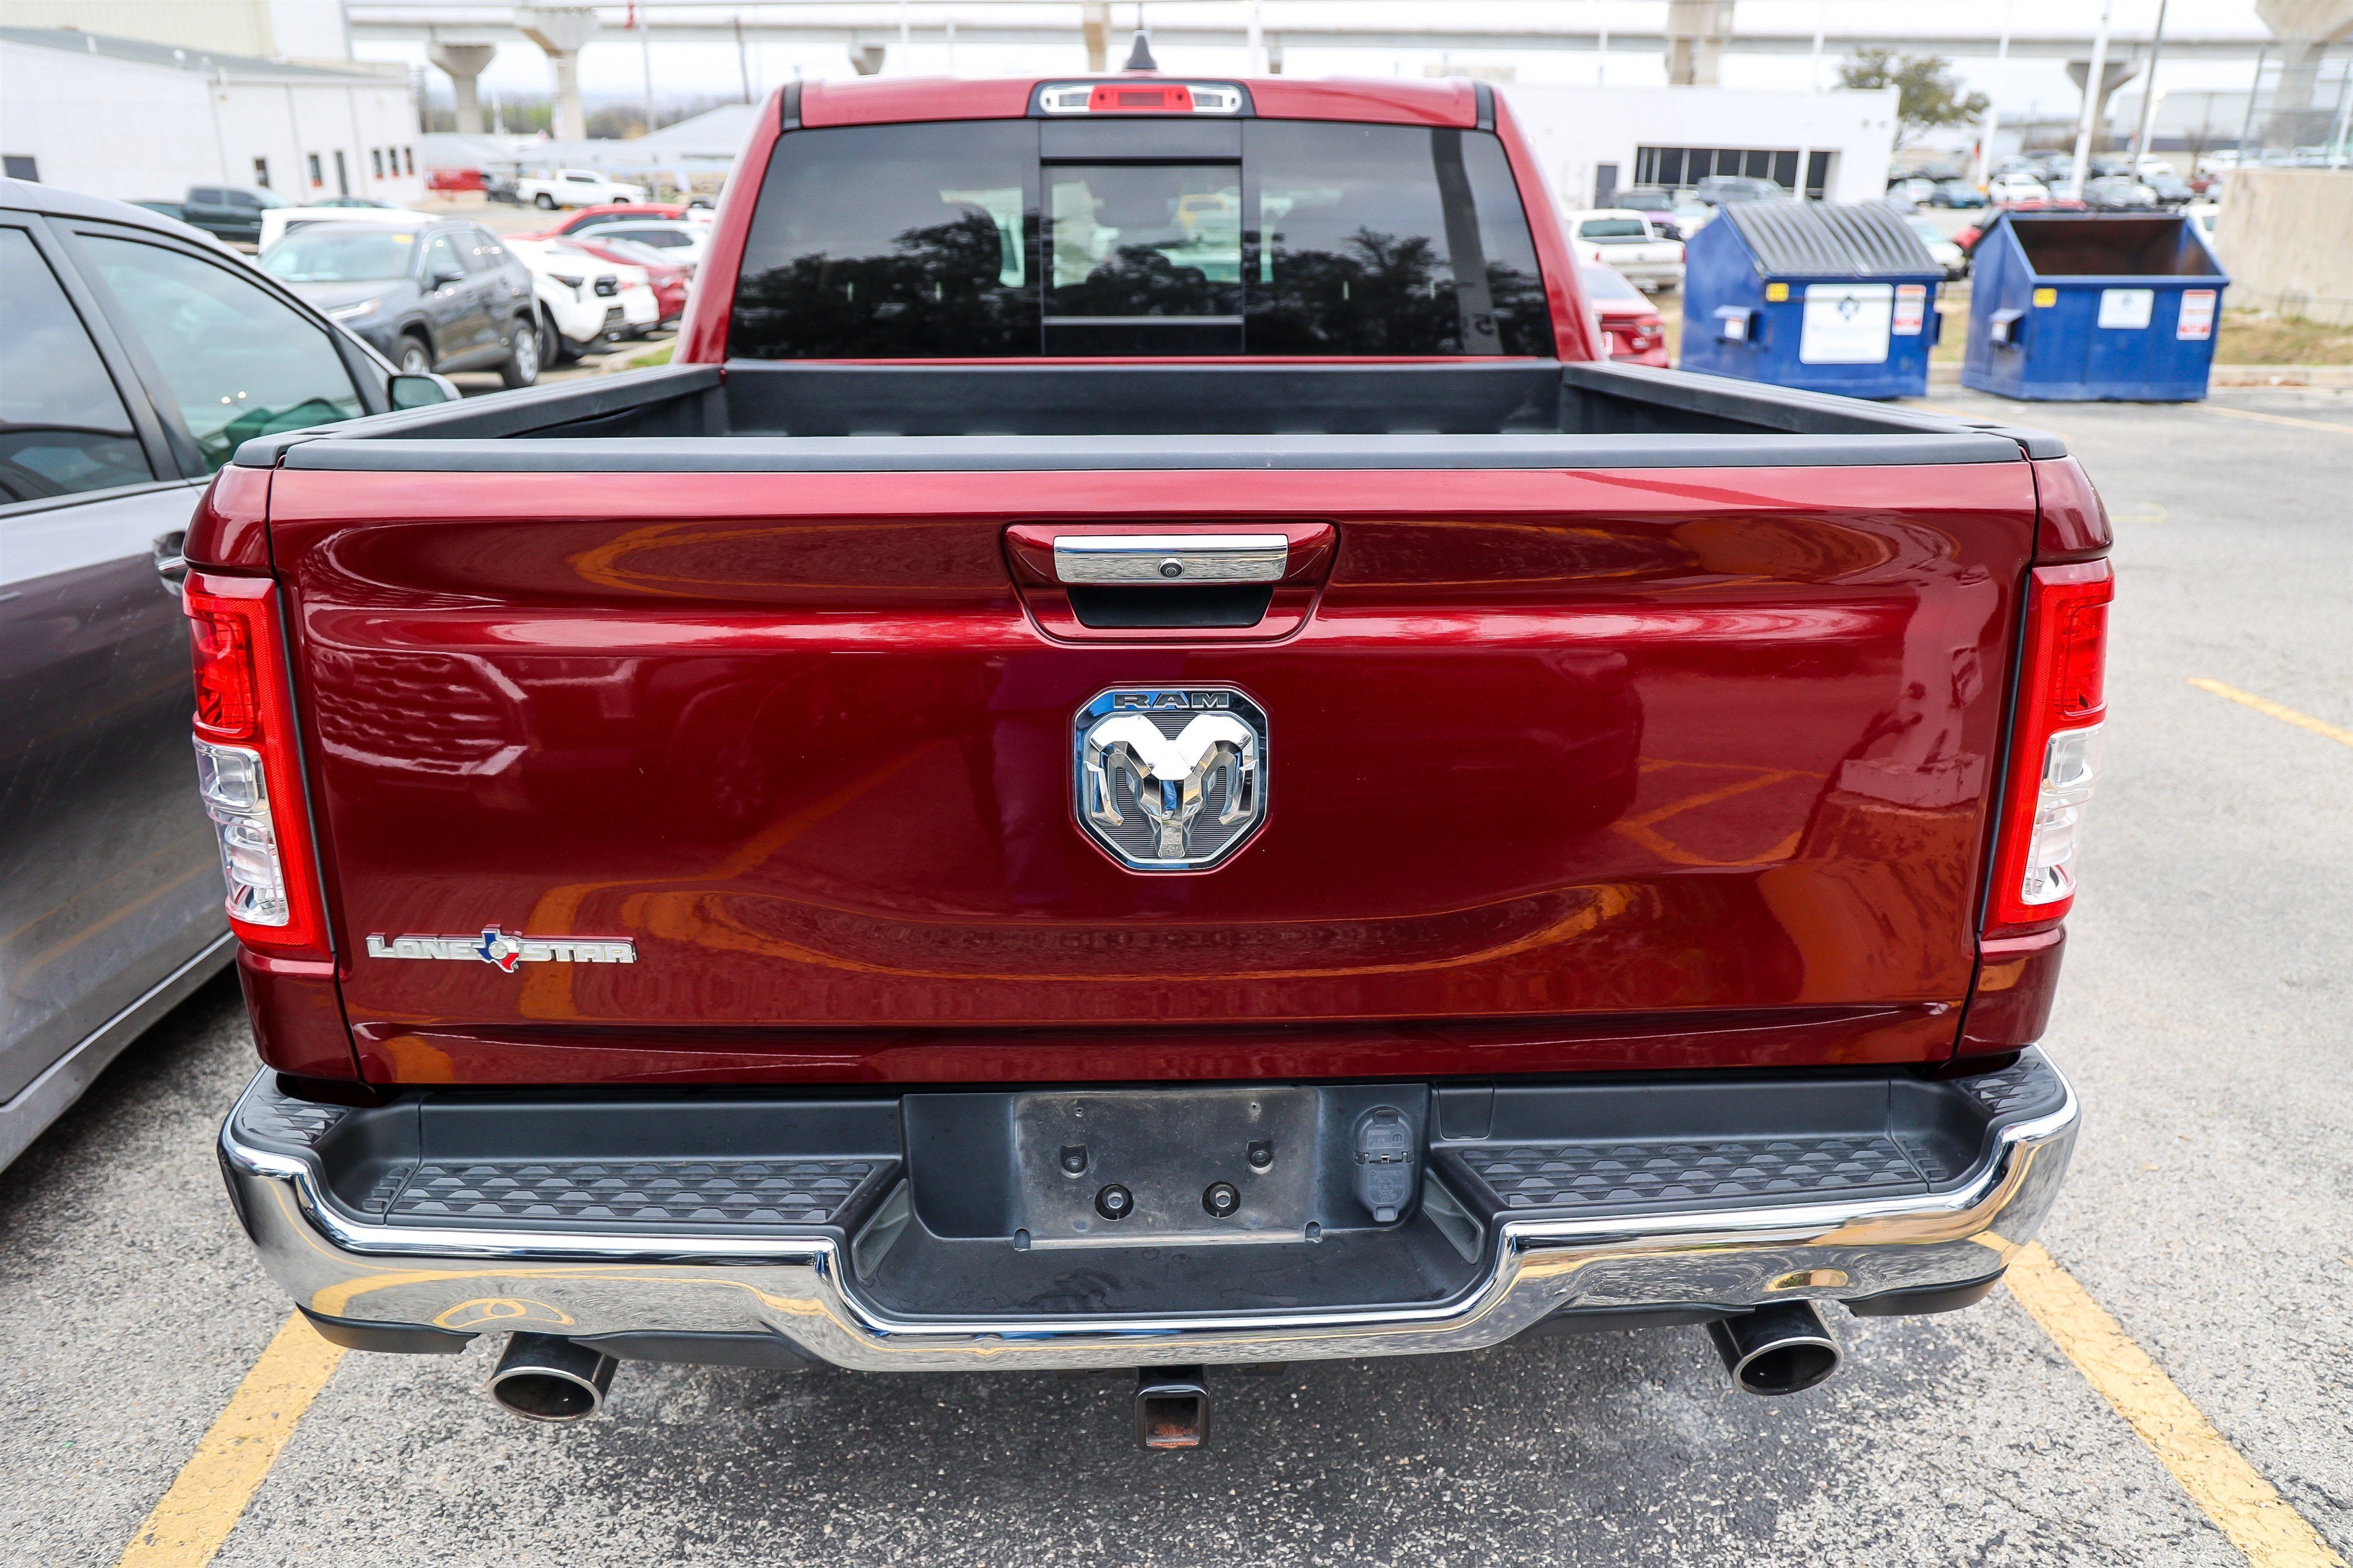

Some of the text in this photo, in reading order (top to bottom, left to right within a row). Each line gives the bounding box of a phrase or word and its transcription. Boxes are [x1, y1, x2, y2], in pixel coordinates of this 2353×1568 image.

[1113, 693, 1229, 709] RAM
[365, 934, 636, 963] LONE STAR
